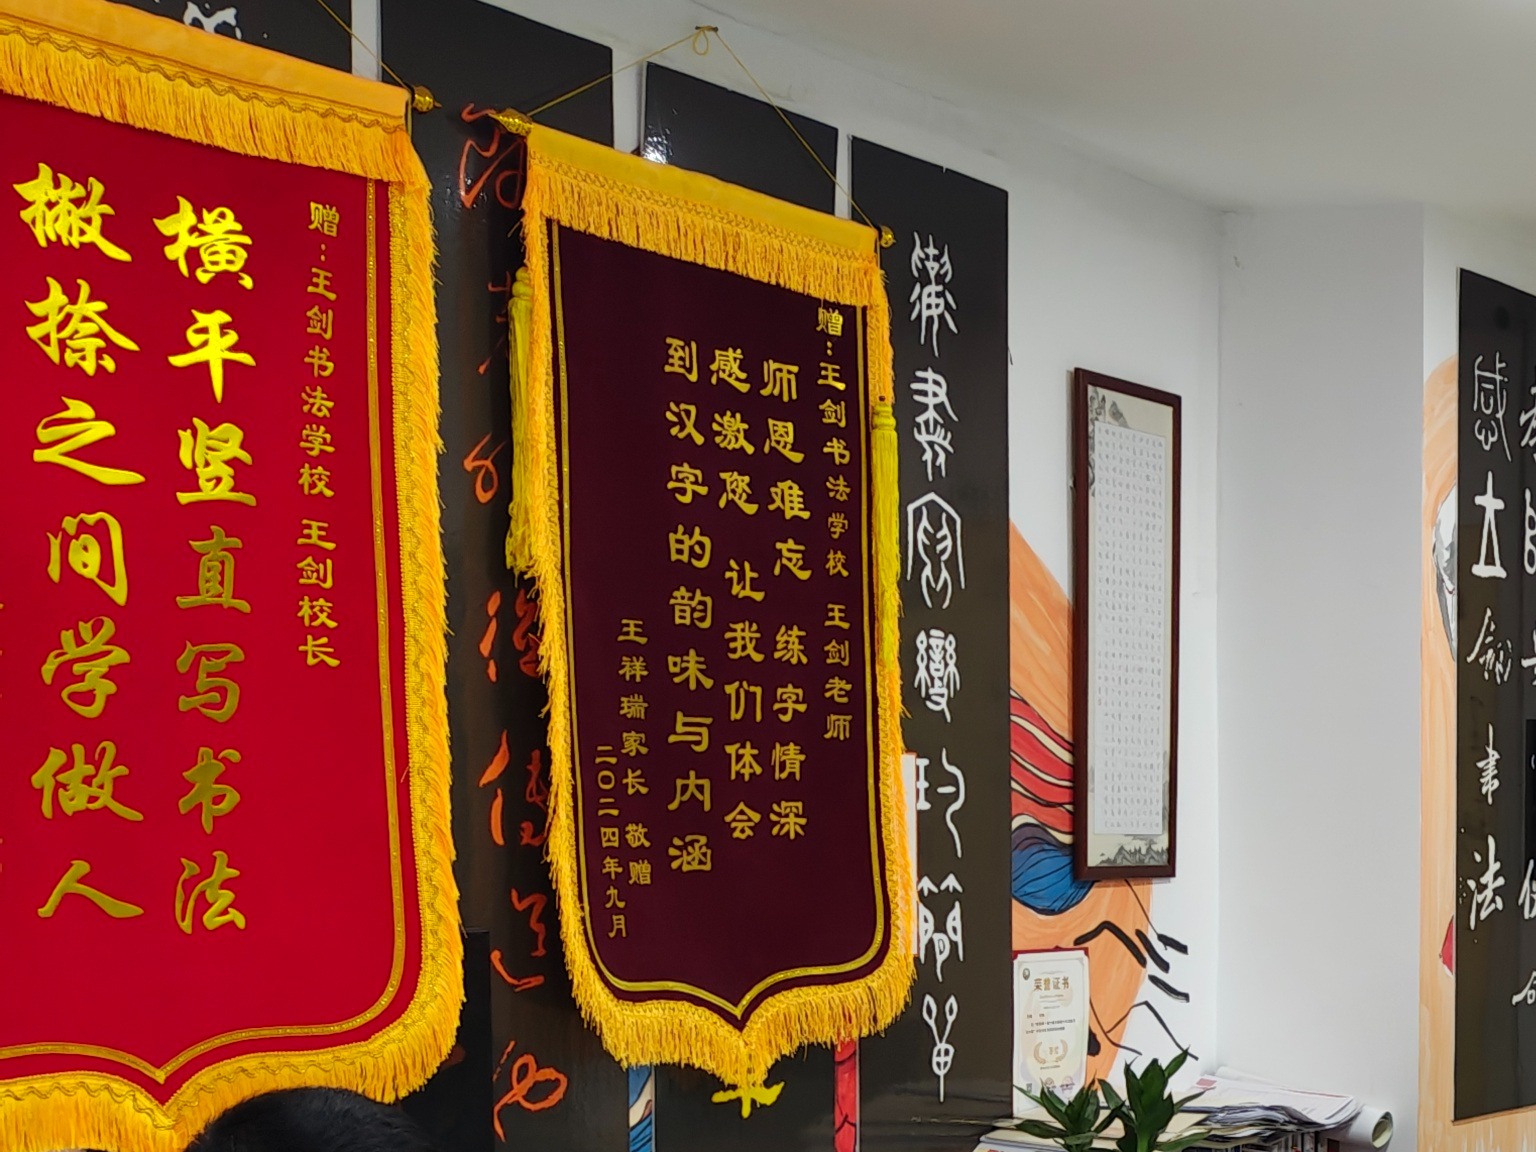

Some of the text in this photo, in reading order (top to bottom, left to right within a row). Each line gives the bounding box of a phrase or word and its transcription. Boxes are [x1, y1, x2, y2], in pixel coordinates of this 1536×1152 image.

[12, 162, 146, 921] 撇捺之间学做人
[153, 195, 257, 935] 横平竖直写书法
[296, 518, 341, 668] 王剑校长
[663, 337, 714, 873] 到汉字的韵味与内涵
[823, 603, 853, 742] 王剑老师
[617, 618, 652, 885] 王祥瑞家长 敬赠
